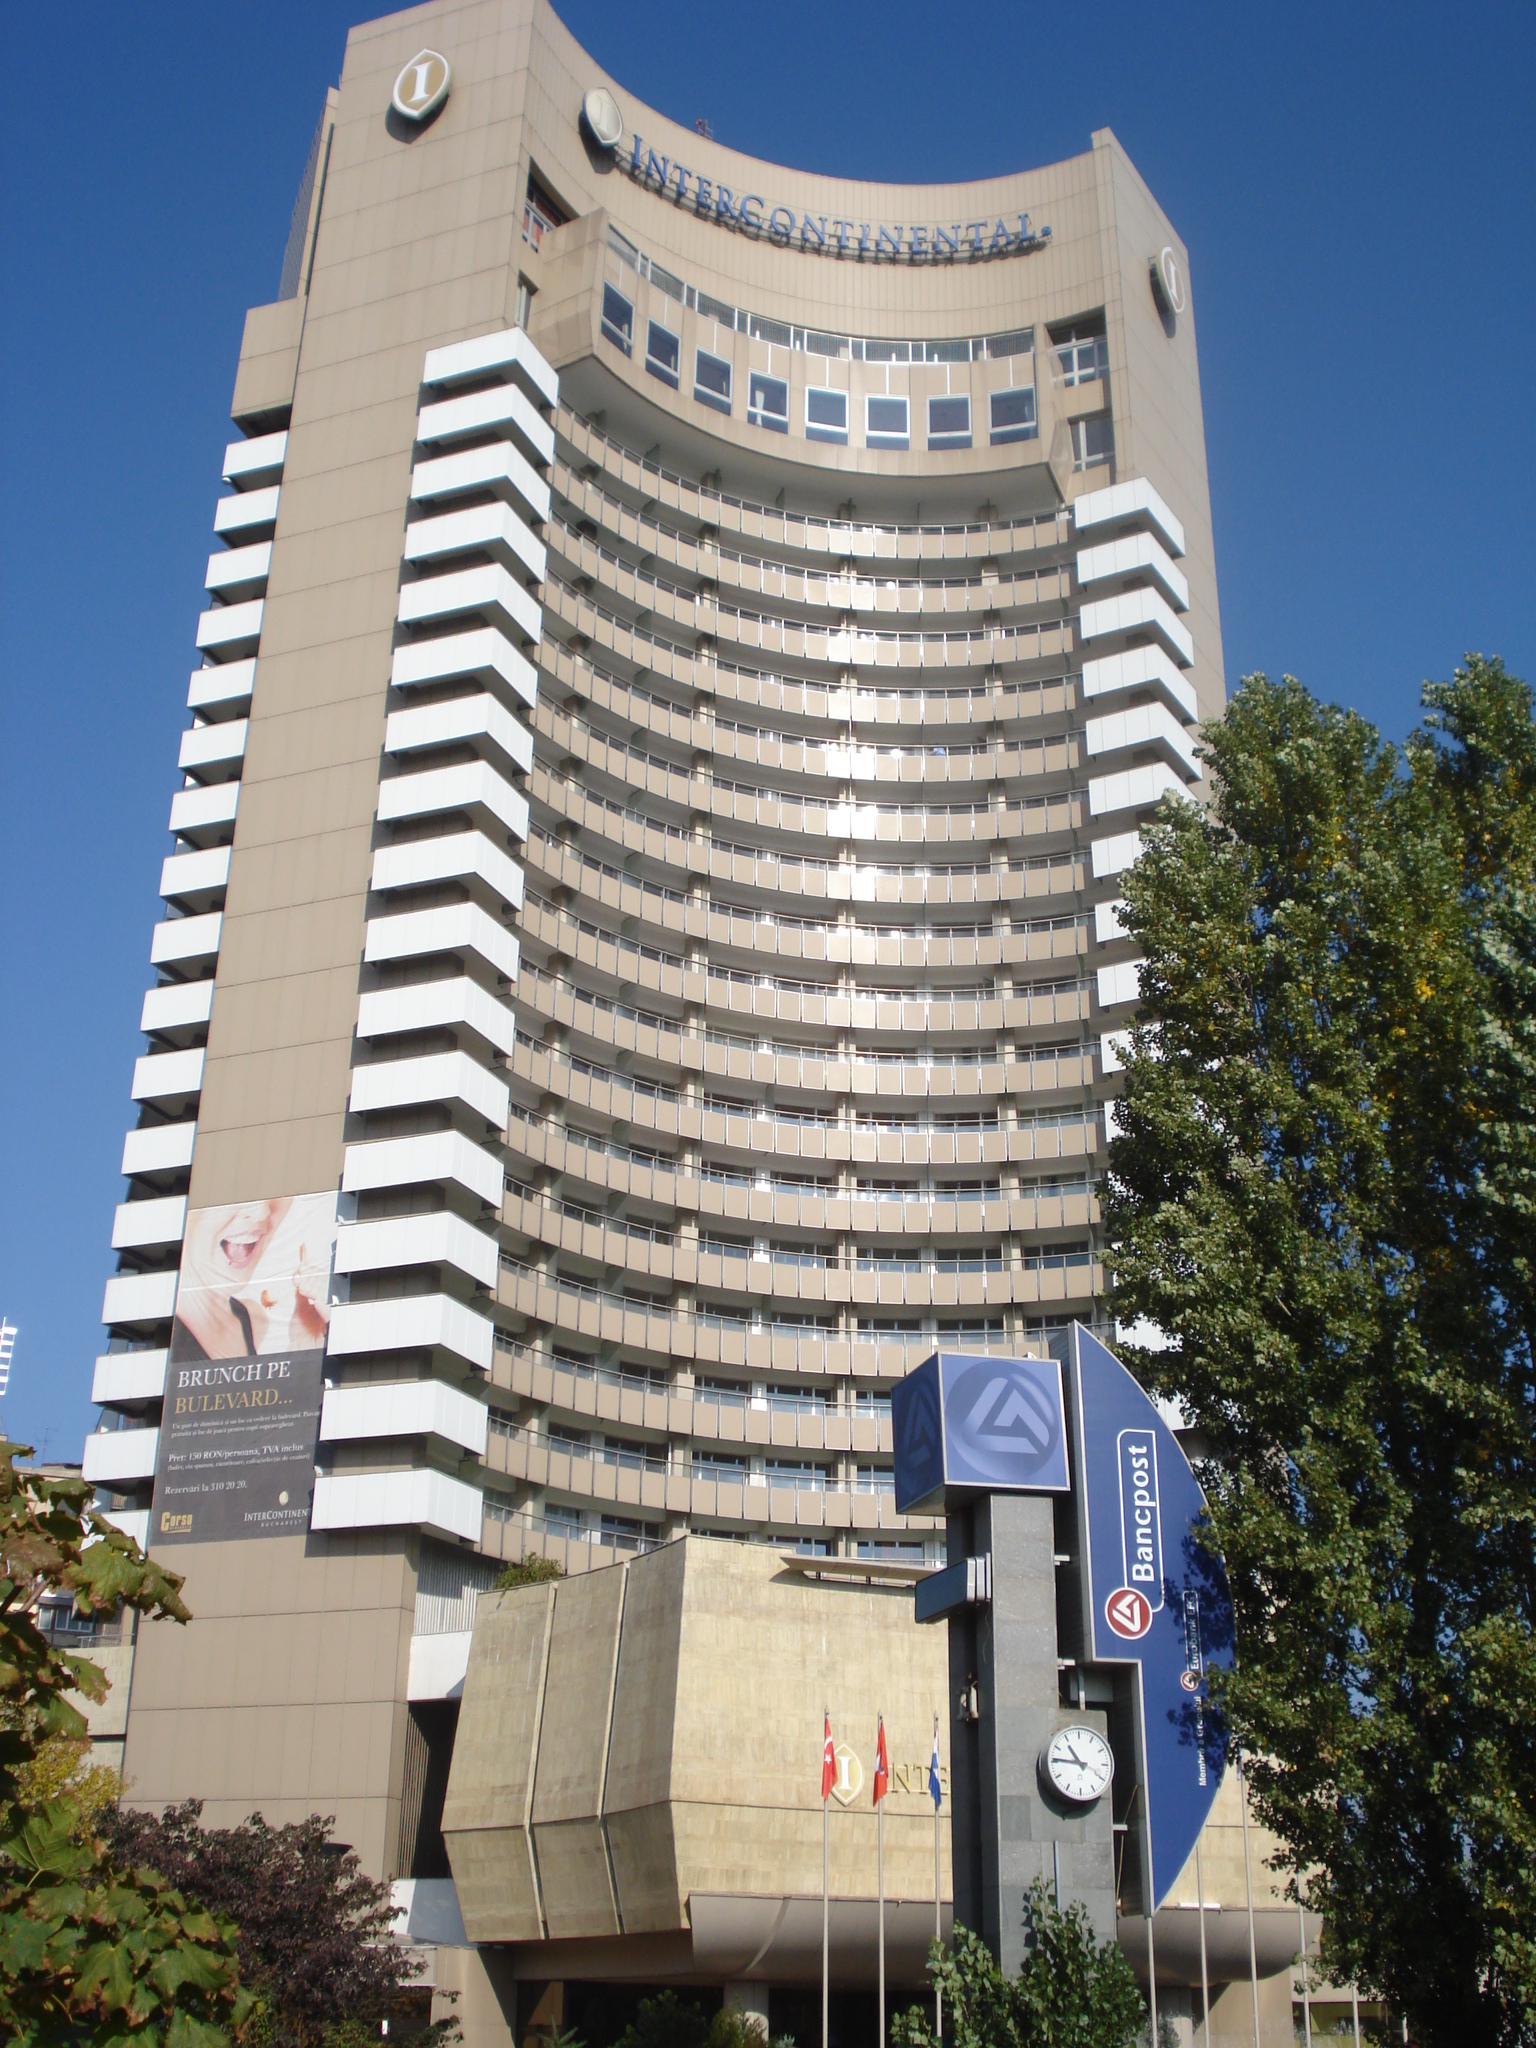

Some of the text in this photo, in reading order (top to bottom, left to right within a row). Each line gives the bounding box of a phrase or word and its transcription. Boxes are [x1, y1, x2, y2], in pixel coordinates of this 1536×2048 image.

[177, 1360, 290, 1388] BRUNCH PE
[175, 1388, 292, 1414] BULEVARD...
[189, 1452, 202, 1460] 150
[262, 1446, 280, 1454] TVA
[281, 1444, 304, 1452] inclus
[202, 1484, 208, 1492] la
[210, 1482, 224, 1491] 310
[226, 1481, 235, 1490] 20
[1128, 1446, 1156, 1582] Bancpost
[1186, 1596, 1196, 1615] EFG
[1188, 1619, 1199, 1670] Eurobank
